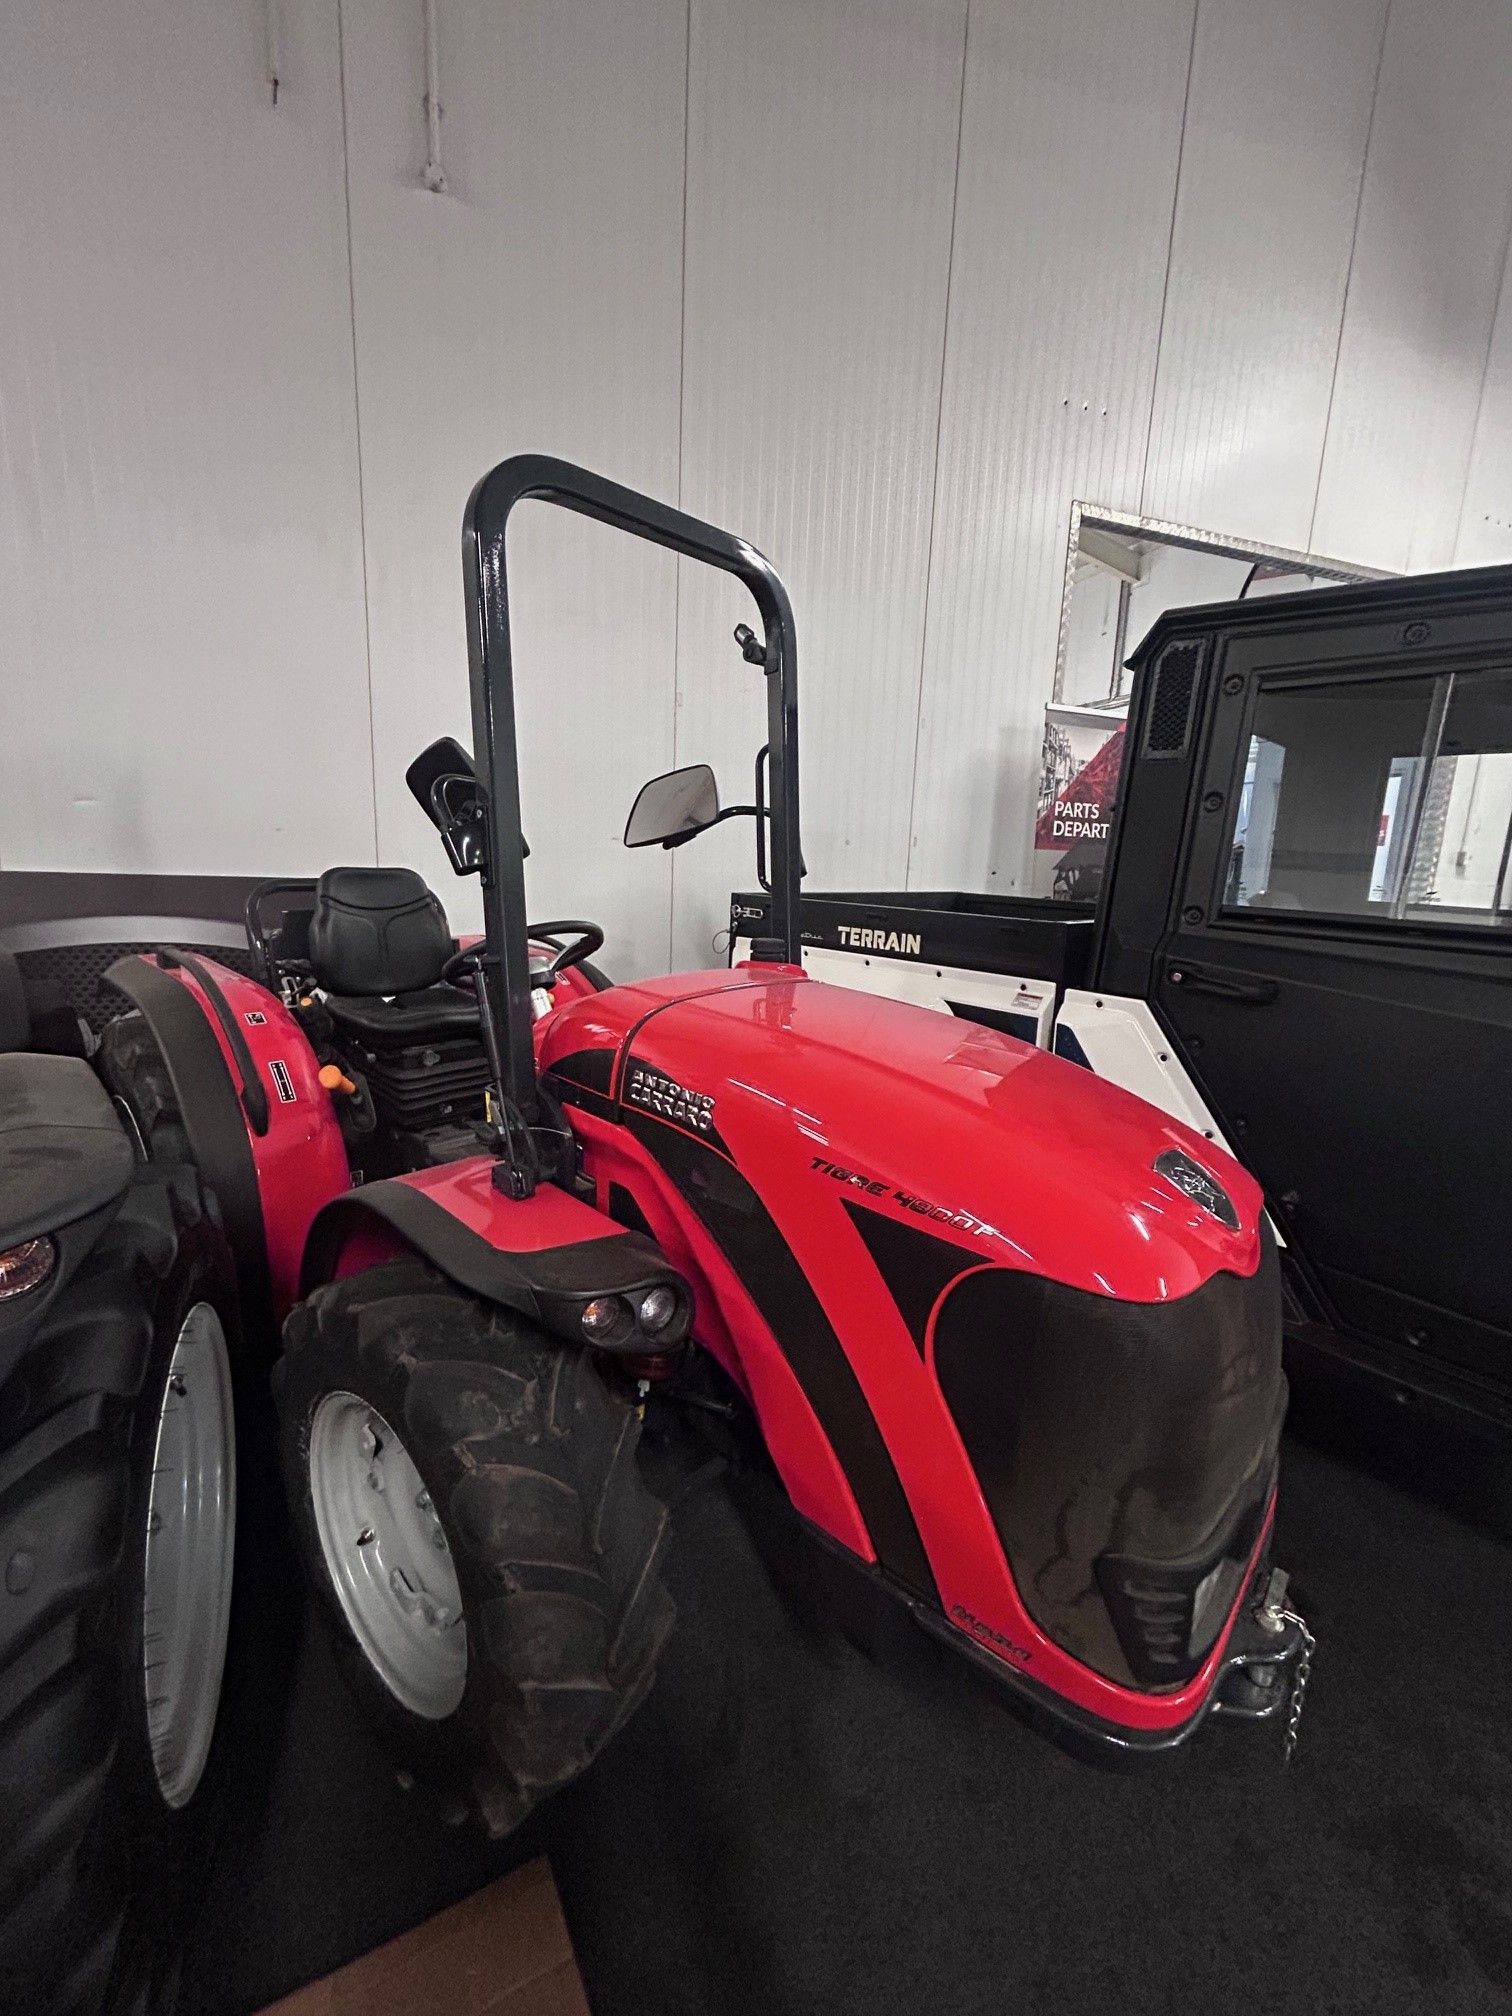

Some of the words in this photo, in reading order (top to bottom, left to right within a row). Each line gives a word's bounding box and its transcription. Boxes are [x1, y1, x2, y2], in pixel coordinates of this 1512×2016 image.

[1054, 800, 1100, 819] PARTS
[1052, 820, 1110, 839] DEPART
[837, 925, 921, 955] TERRAIN
[633, 1069, 716, 1109] ANTONIO
[630, 1083, 712, 1131] CARRARO
[810, 1156, 890, 1197] TIGRE
